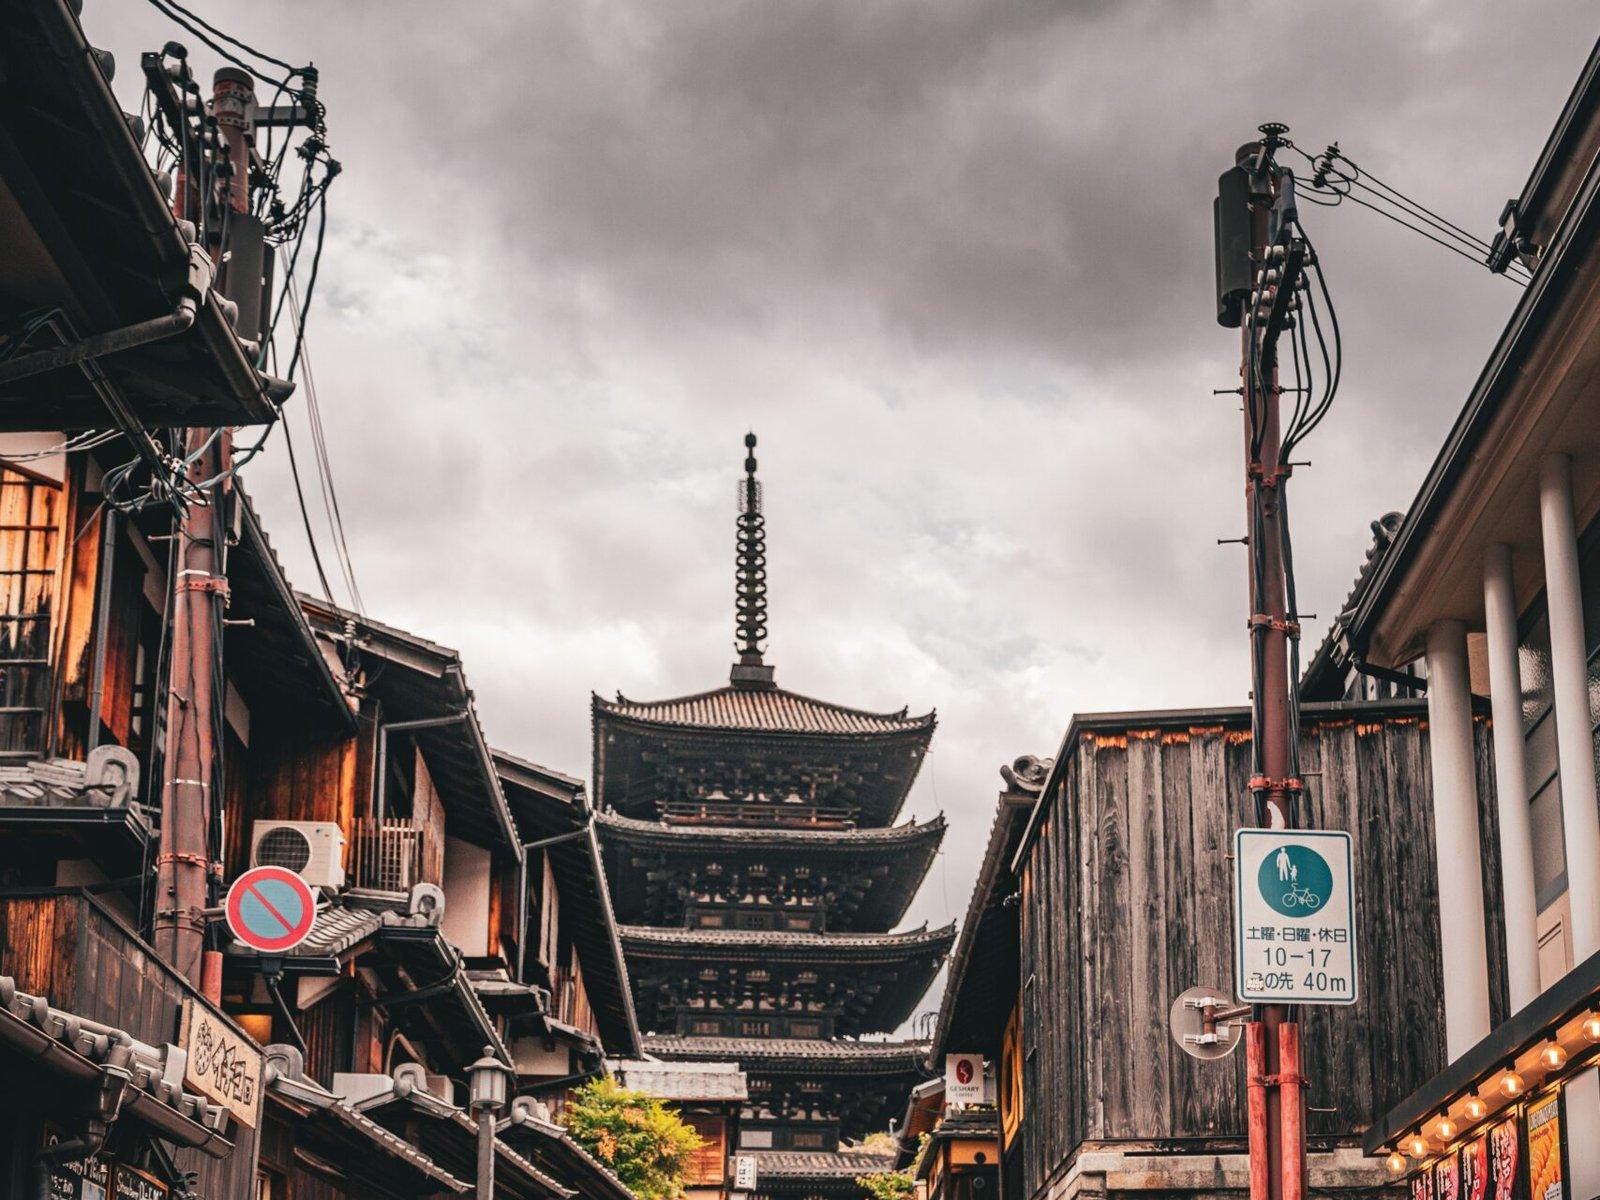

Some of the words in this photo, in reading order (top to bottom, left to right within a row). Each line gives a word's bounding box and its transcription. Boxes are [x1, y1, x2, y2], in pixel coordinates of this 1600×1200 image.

[1246, 925, 1347, 943] 土曜・日曜・休日
[1303, 971, 1346, 992] 40m
